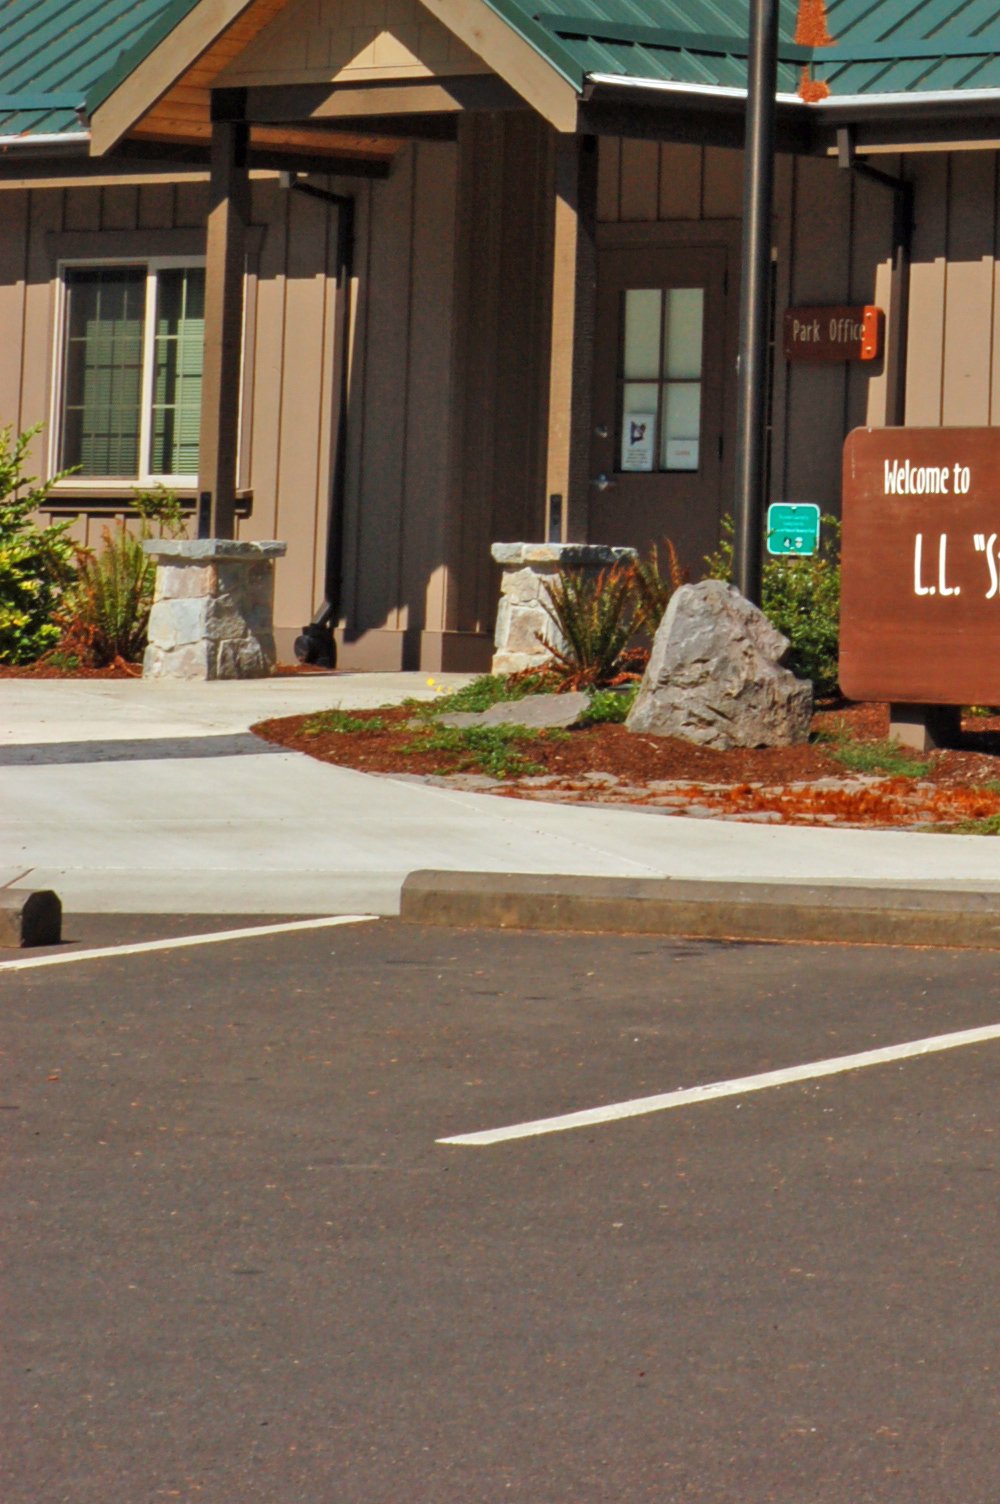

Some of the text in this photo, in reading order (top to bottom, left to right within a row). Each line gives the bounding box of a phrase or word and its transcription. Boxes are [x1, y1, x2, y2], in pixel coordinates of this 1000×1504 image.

[793, 318, 865, 342] Park Office
[884, 459, 970, 494] Welcome to
[914, 533, 961, 596] L.L.
